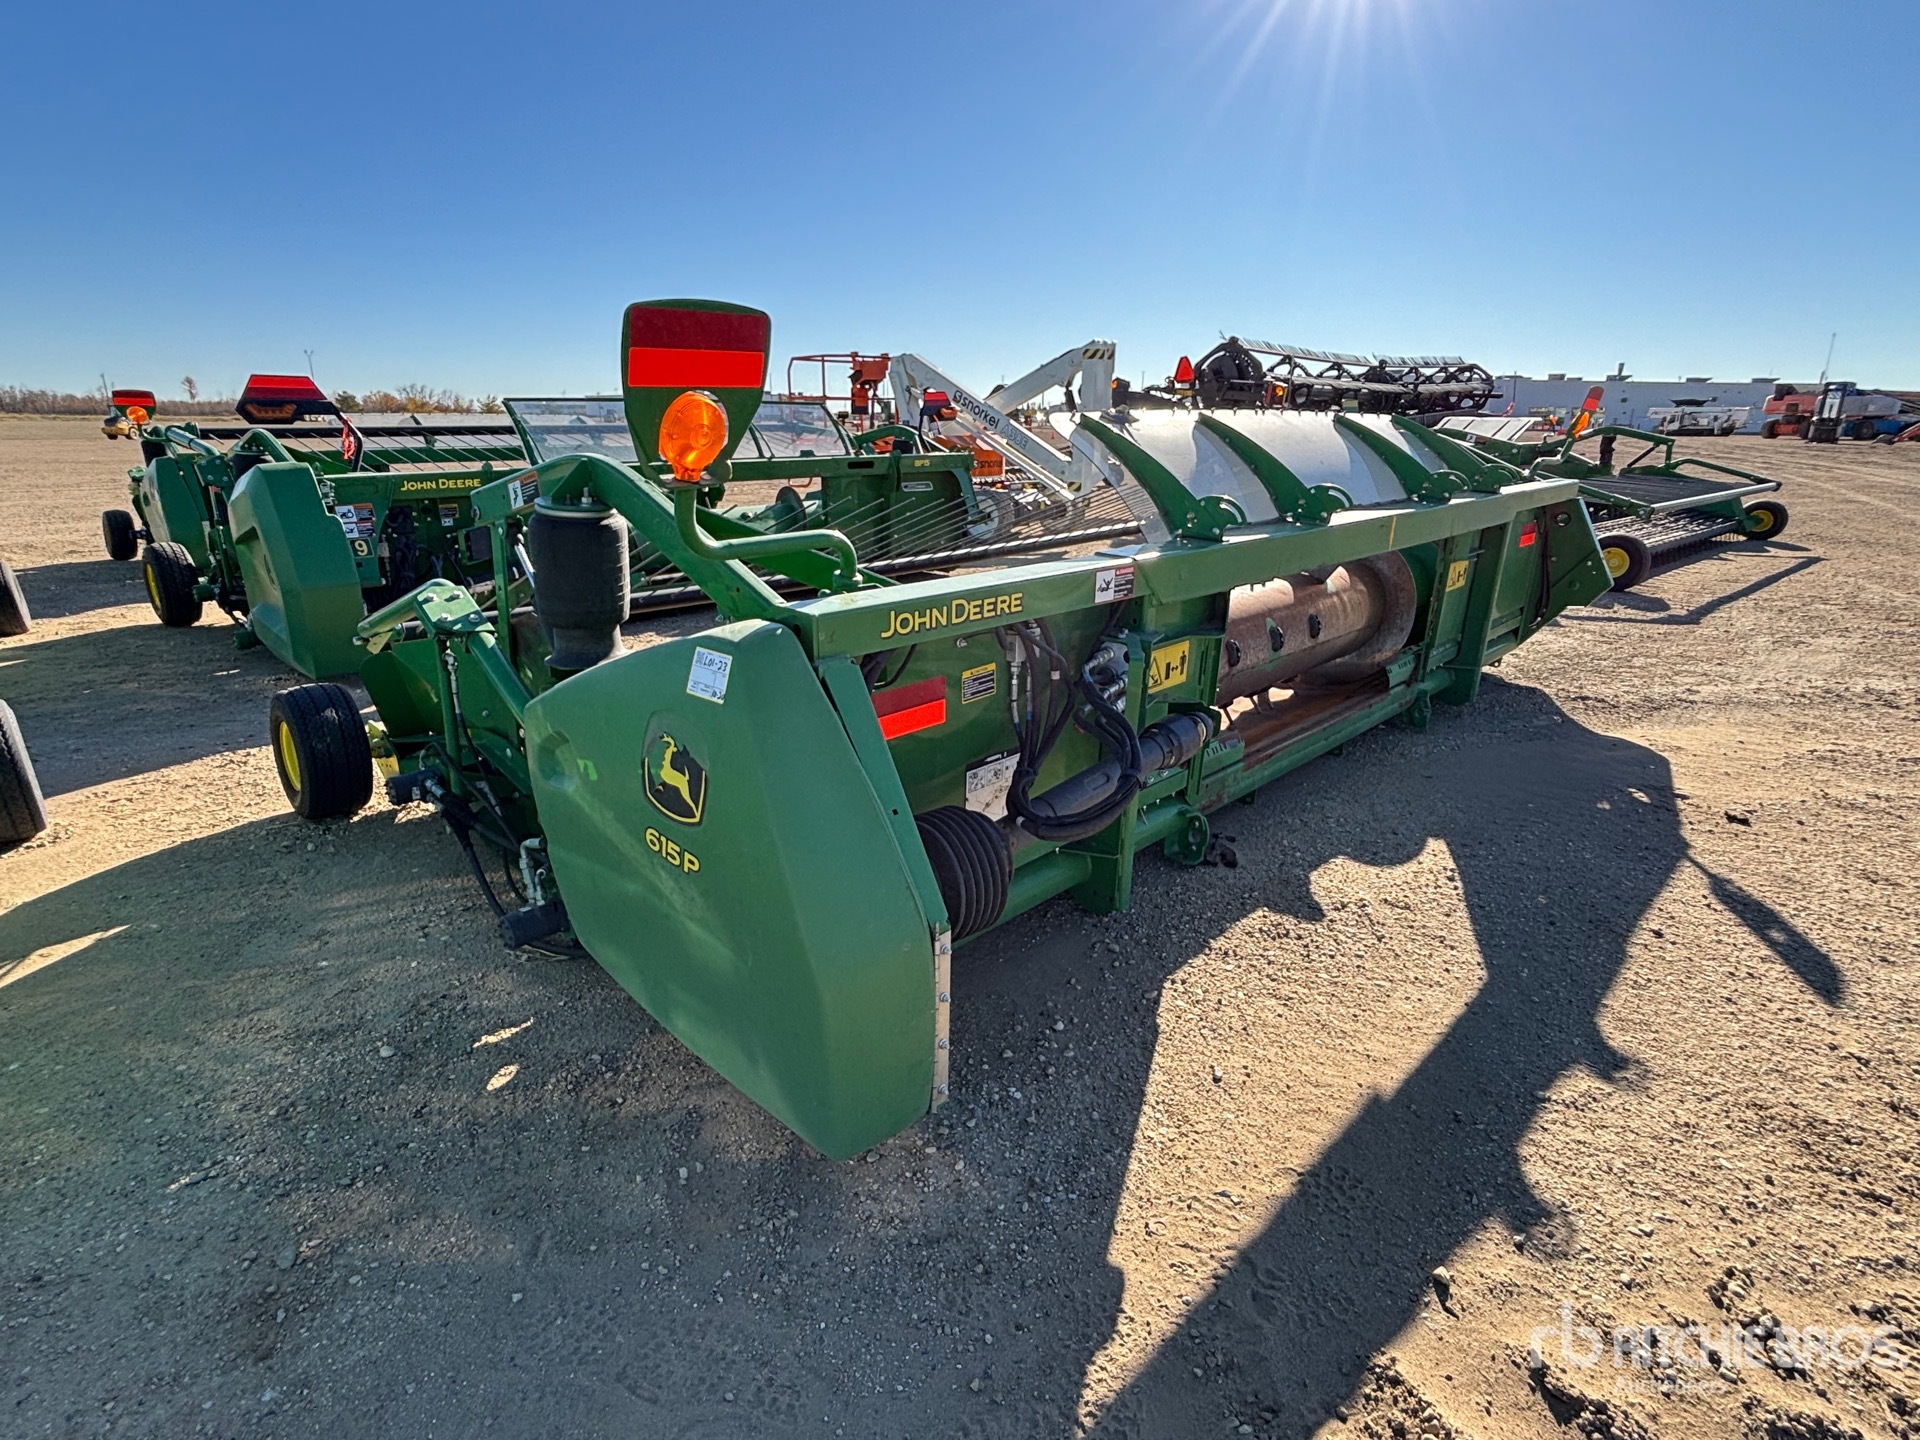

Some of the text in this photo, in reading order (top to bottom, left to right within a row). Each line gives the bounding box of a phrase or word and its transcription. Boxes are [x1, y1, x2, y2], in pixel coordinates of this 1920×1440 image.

[961, 398, 1000, 429] snorkel
[401, 478, 482, 491] JOHN DEERE
[354, 540, 368, 556] 9
[880, 592, 1023, 638] JOHN DEERE
[645, 827, 700, 874] 615P
